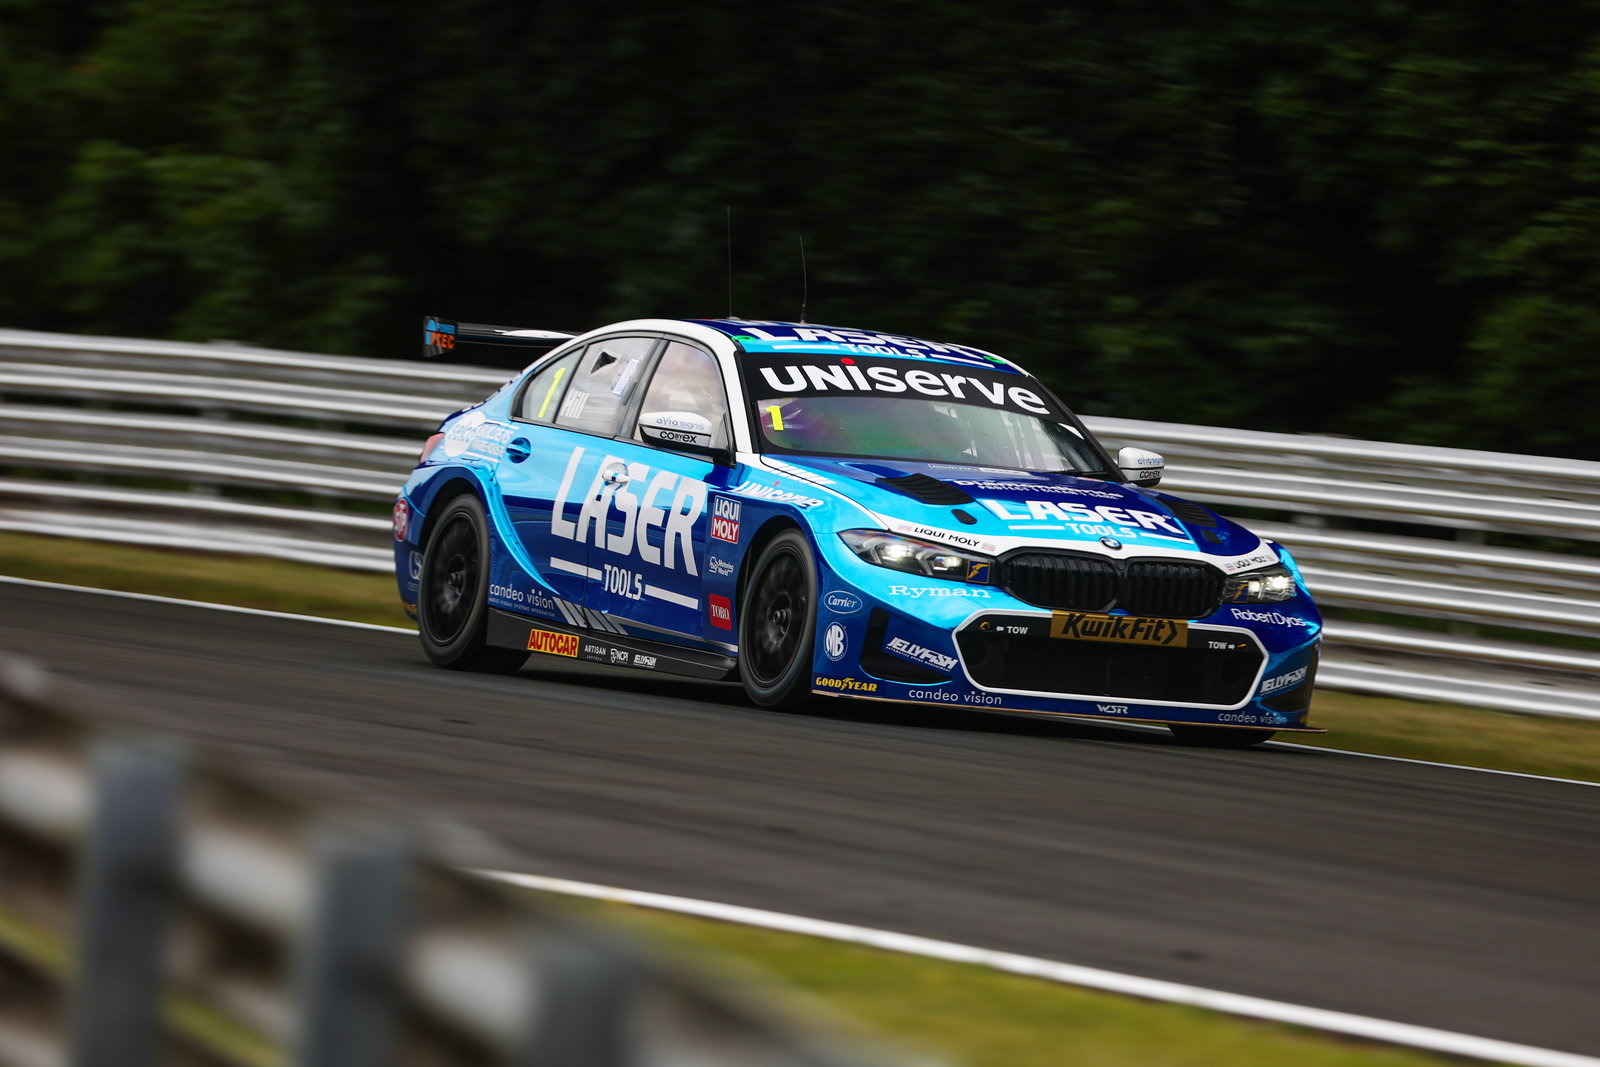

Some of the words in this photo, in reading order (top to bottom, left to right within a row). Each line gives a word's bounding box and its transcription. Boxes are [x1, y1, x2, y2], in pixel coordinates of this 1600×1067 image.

[740, 327, 988, 359] LASER
[839, 343, 927, 359] TOOLS
[538, 367, 566, 418] 1
[765, 405, 784, 431] 1
[551, 446, 708, 577] LASER
[714, 498, 740, 521] LIQUI
[978, 499, 1187, 535] LASER
[712, 518, 739, 541] MOLY
[914, 527, 945, 539] LIQUI
[948, 534, 980, 547] MOLY
[1065, 523, 1137, 539] TOOLS
[603, 563, 643, 601] TOOLS
[888, 585, 991, 599] Ryman
[489, 583, 524, 602] candeo
[527, 588, 554, 610] vision
[828, 594, 857, 608] Carrier
[710, 604, 731, 621] TORO
[1006, 626, 1028, 635] TOW
[528, 630, 578, 657] AUTOCAR
[584, 645, 607, 656] ARTISAN
[1208, 641, 1227, 650] TOW
[908, 688, 958, 702] candeo
[963, 691, 1002, 705] vision
[1218, 711, 1257, 723] candeo
[1260, 712, 1287, 725] vision
